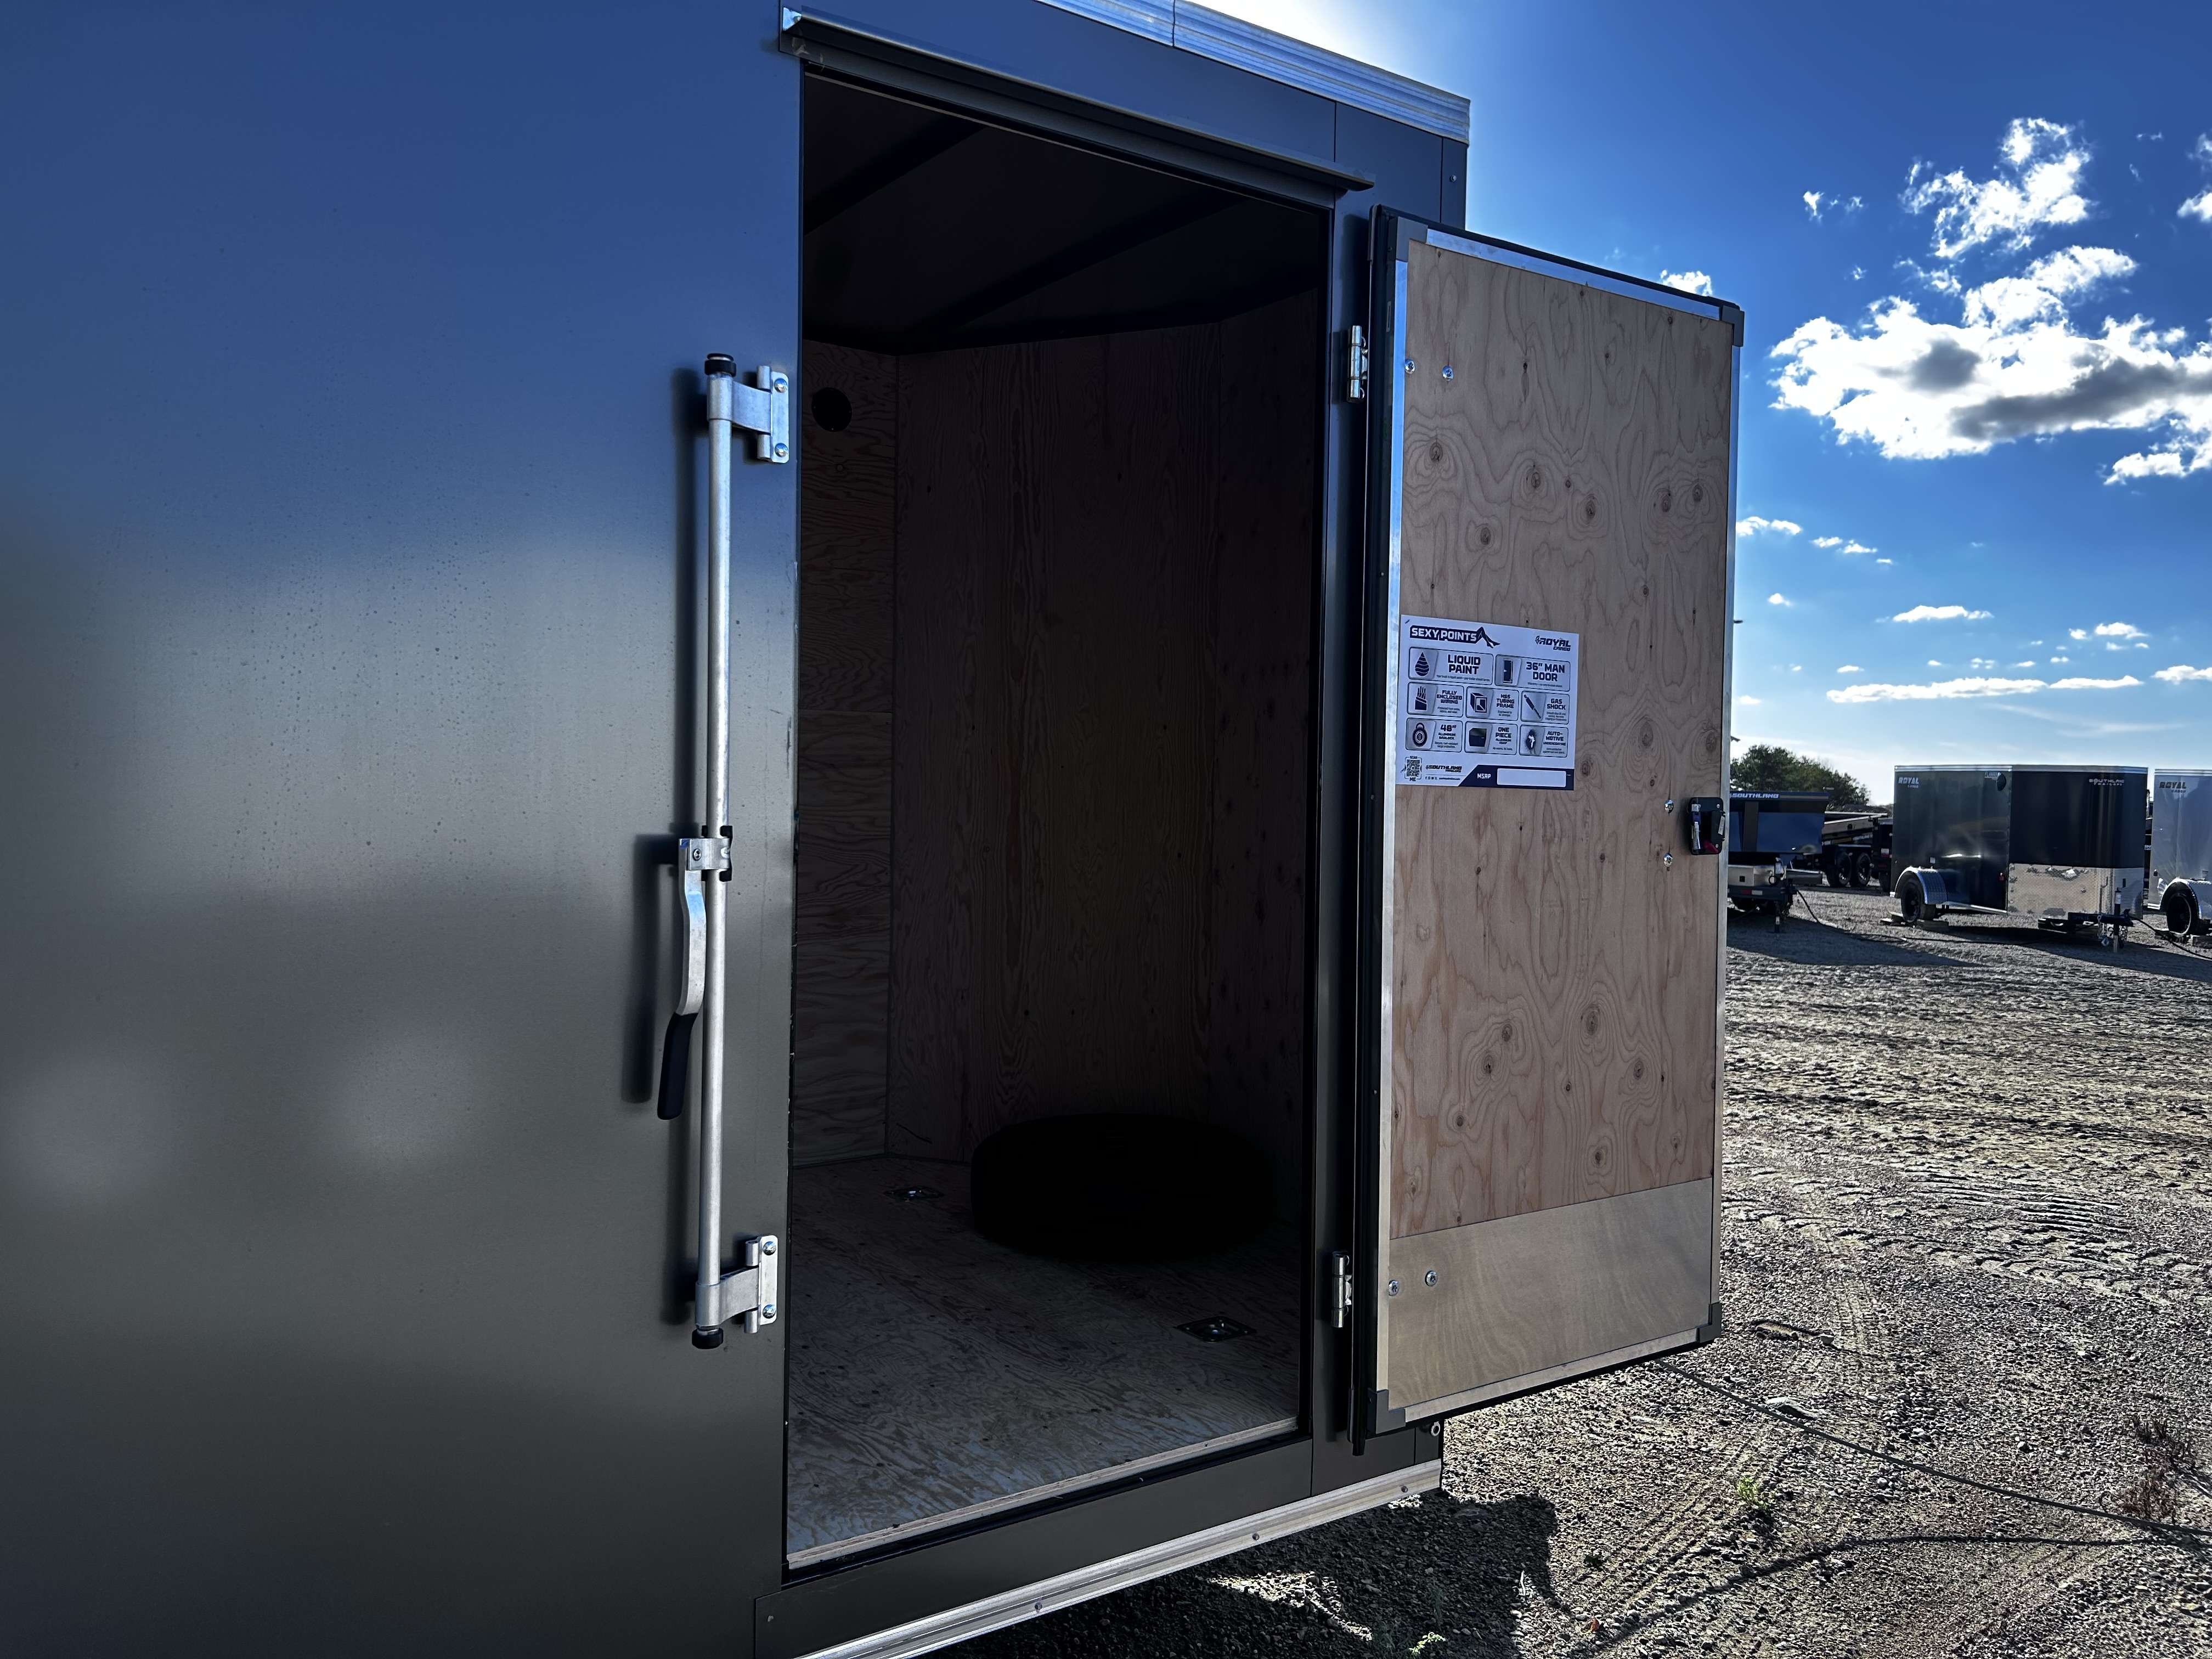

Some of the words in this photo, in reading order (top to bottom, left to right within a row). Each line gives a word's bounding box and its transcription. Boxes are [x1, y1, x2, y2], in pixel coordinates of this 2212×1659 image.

[1412, 628, 1439, 638] SEXY
[1440, 631, 1476, 641] POINTS
[1539, 637, 1571, 647] ROYAL
[1447, 654, 1481, 665] LIQUID
[1448, 664, 1480, 675] PAINT
[1526, 662, 1543, 670] 36"
[1544, 663, 1565, 673] MAN
[1532, 672, 1558, 681] DOOR
